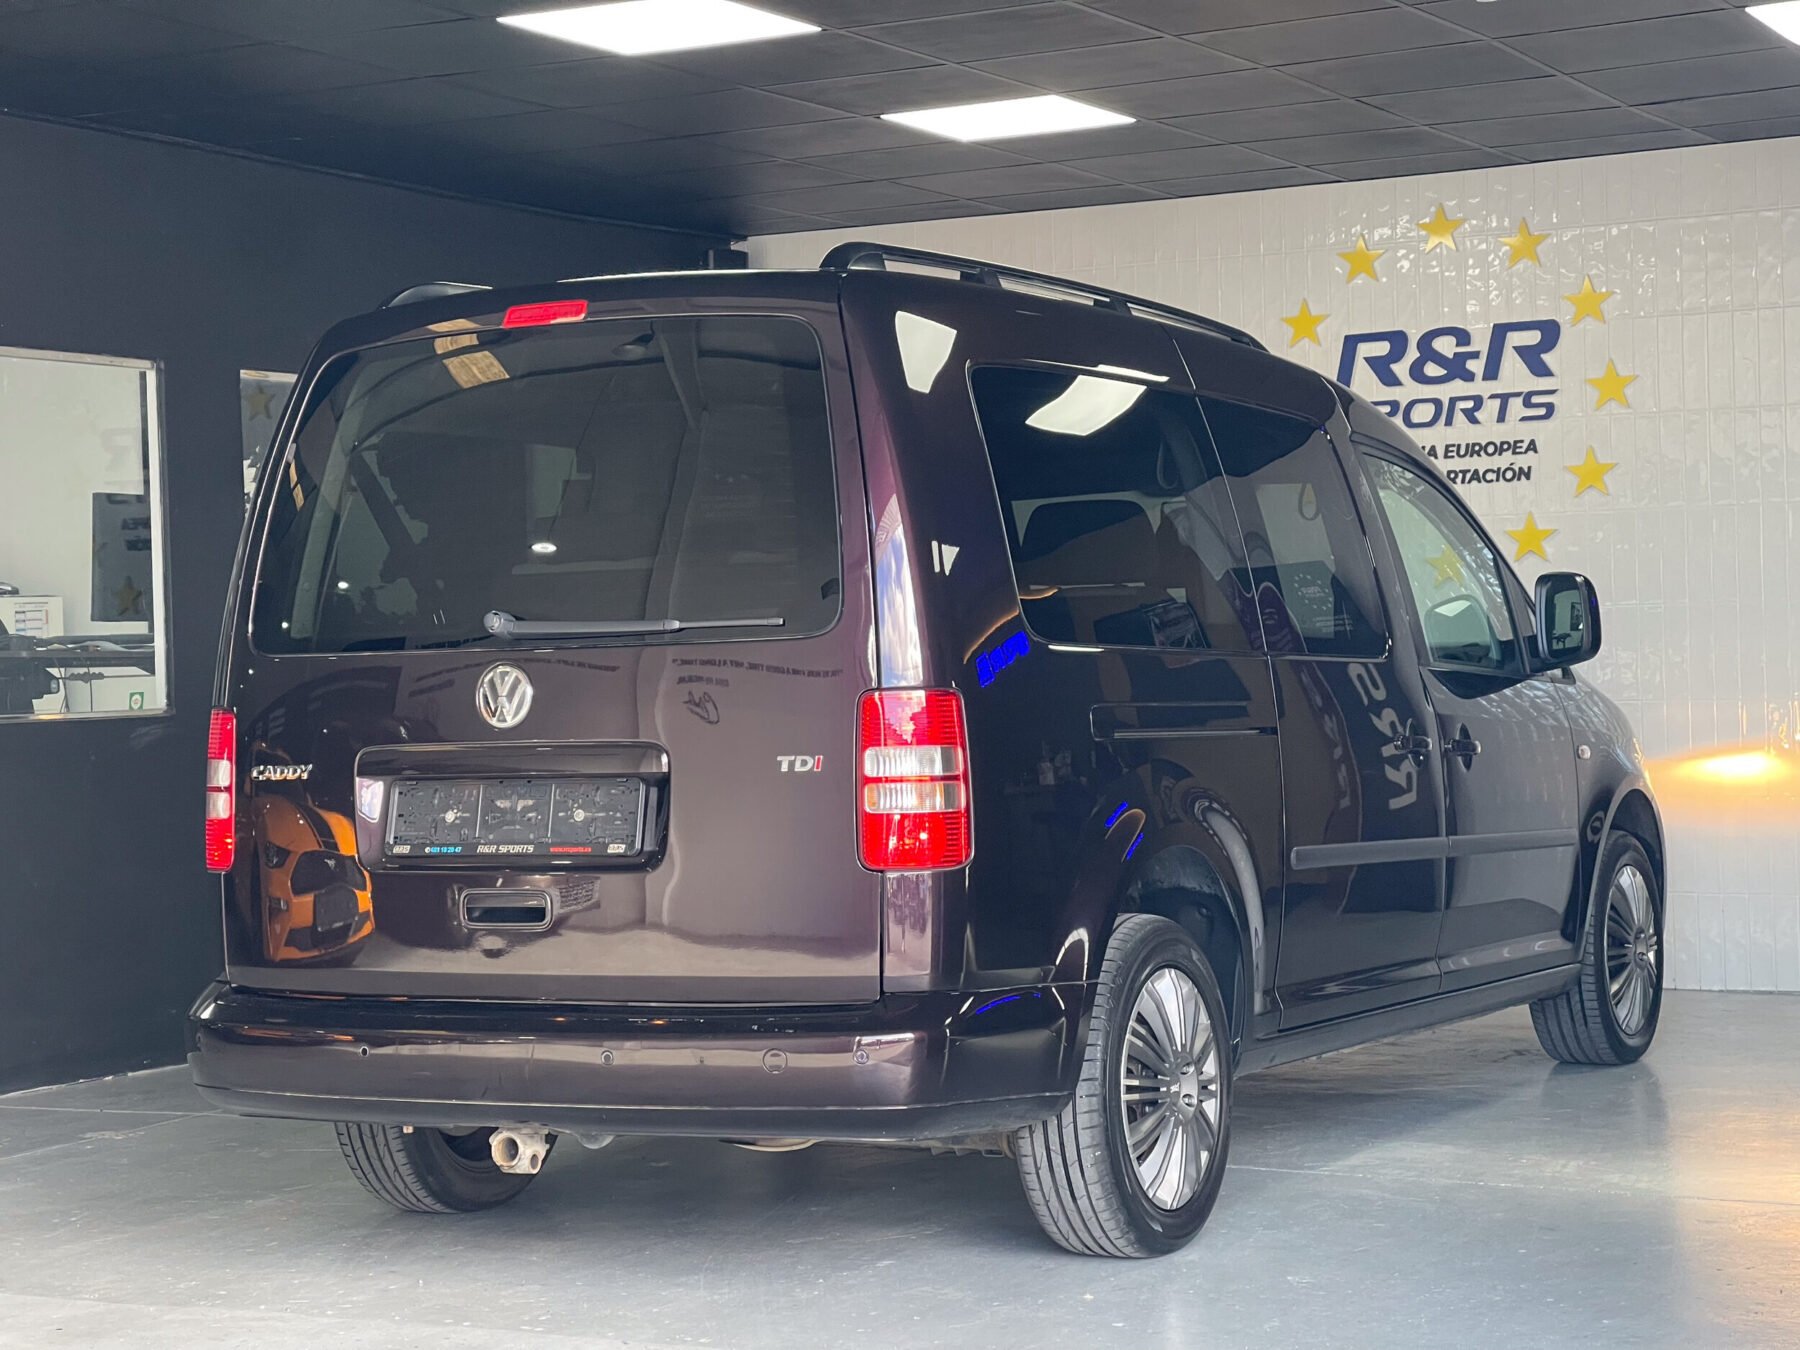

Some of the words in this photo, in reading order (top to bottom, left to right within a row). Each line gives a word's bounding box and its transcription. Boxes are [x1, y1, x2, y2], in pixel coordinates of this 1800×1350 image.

[1336, 318, 1561, 387] R&R
[1370, 388, 1560, 429] PORTS
[1443, 438, 1539, 460] EUROPEA
[1446, 462, 1532, 485] RTACIÓN
[251, 763, 313, 781] CADDY
[776, 755, 823, 772] TDI
[477, 844, 497, 854] R&R
[498, 844, 535, 854] SPORTS
